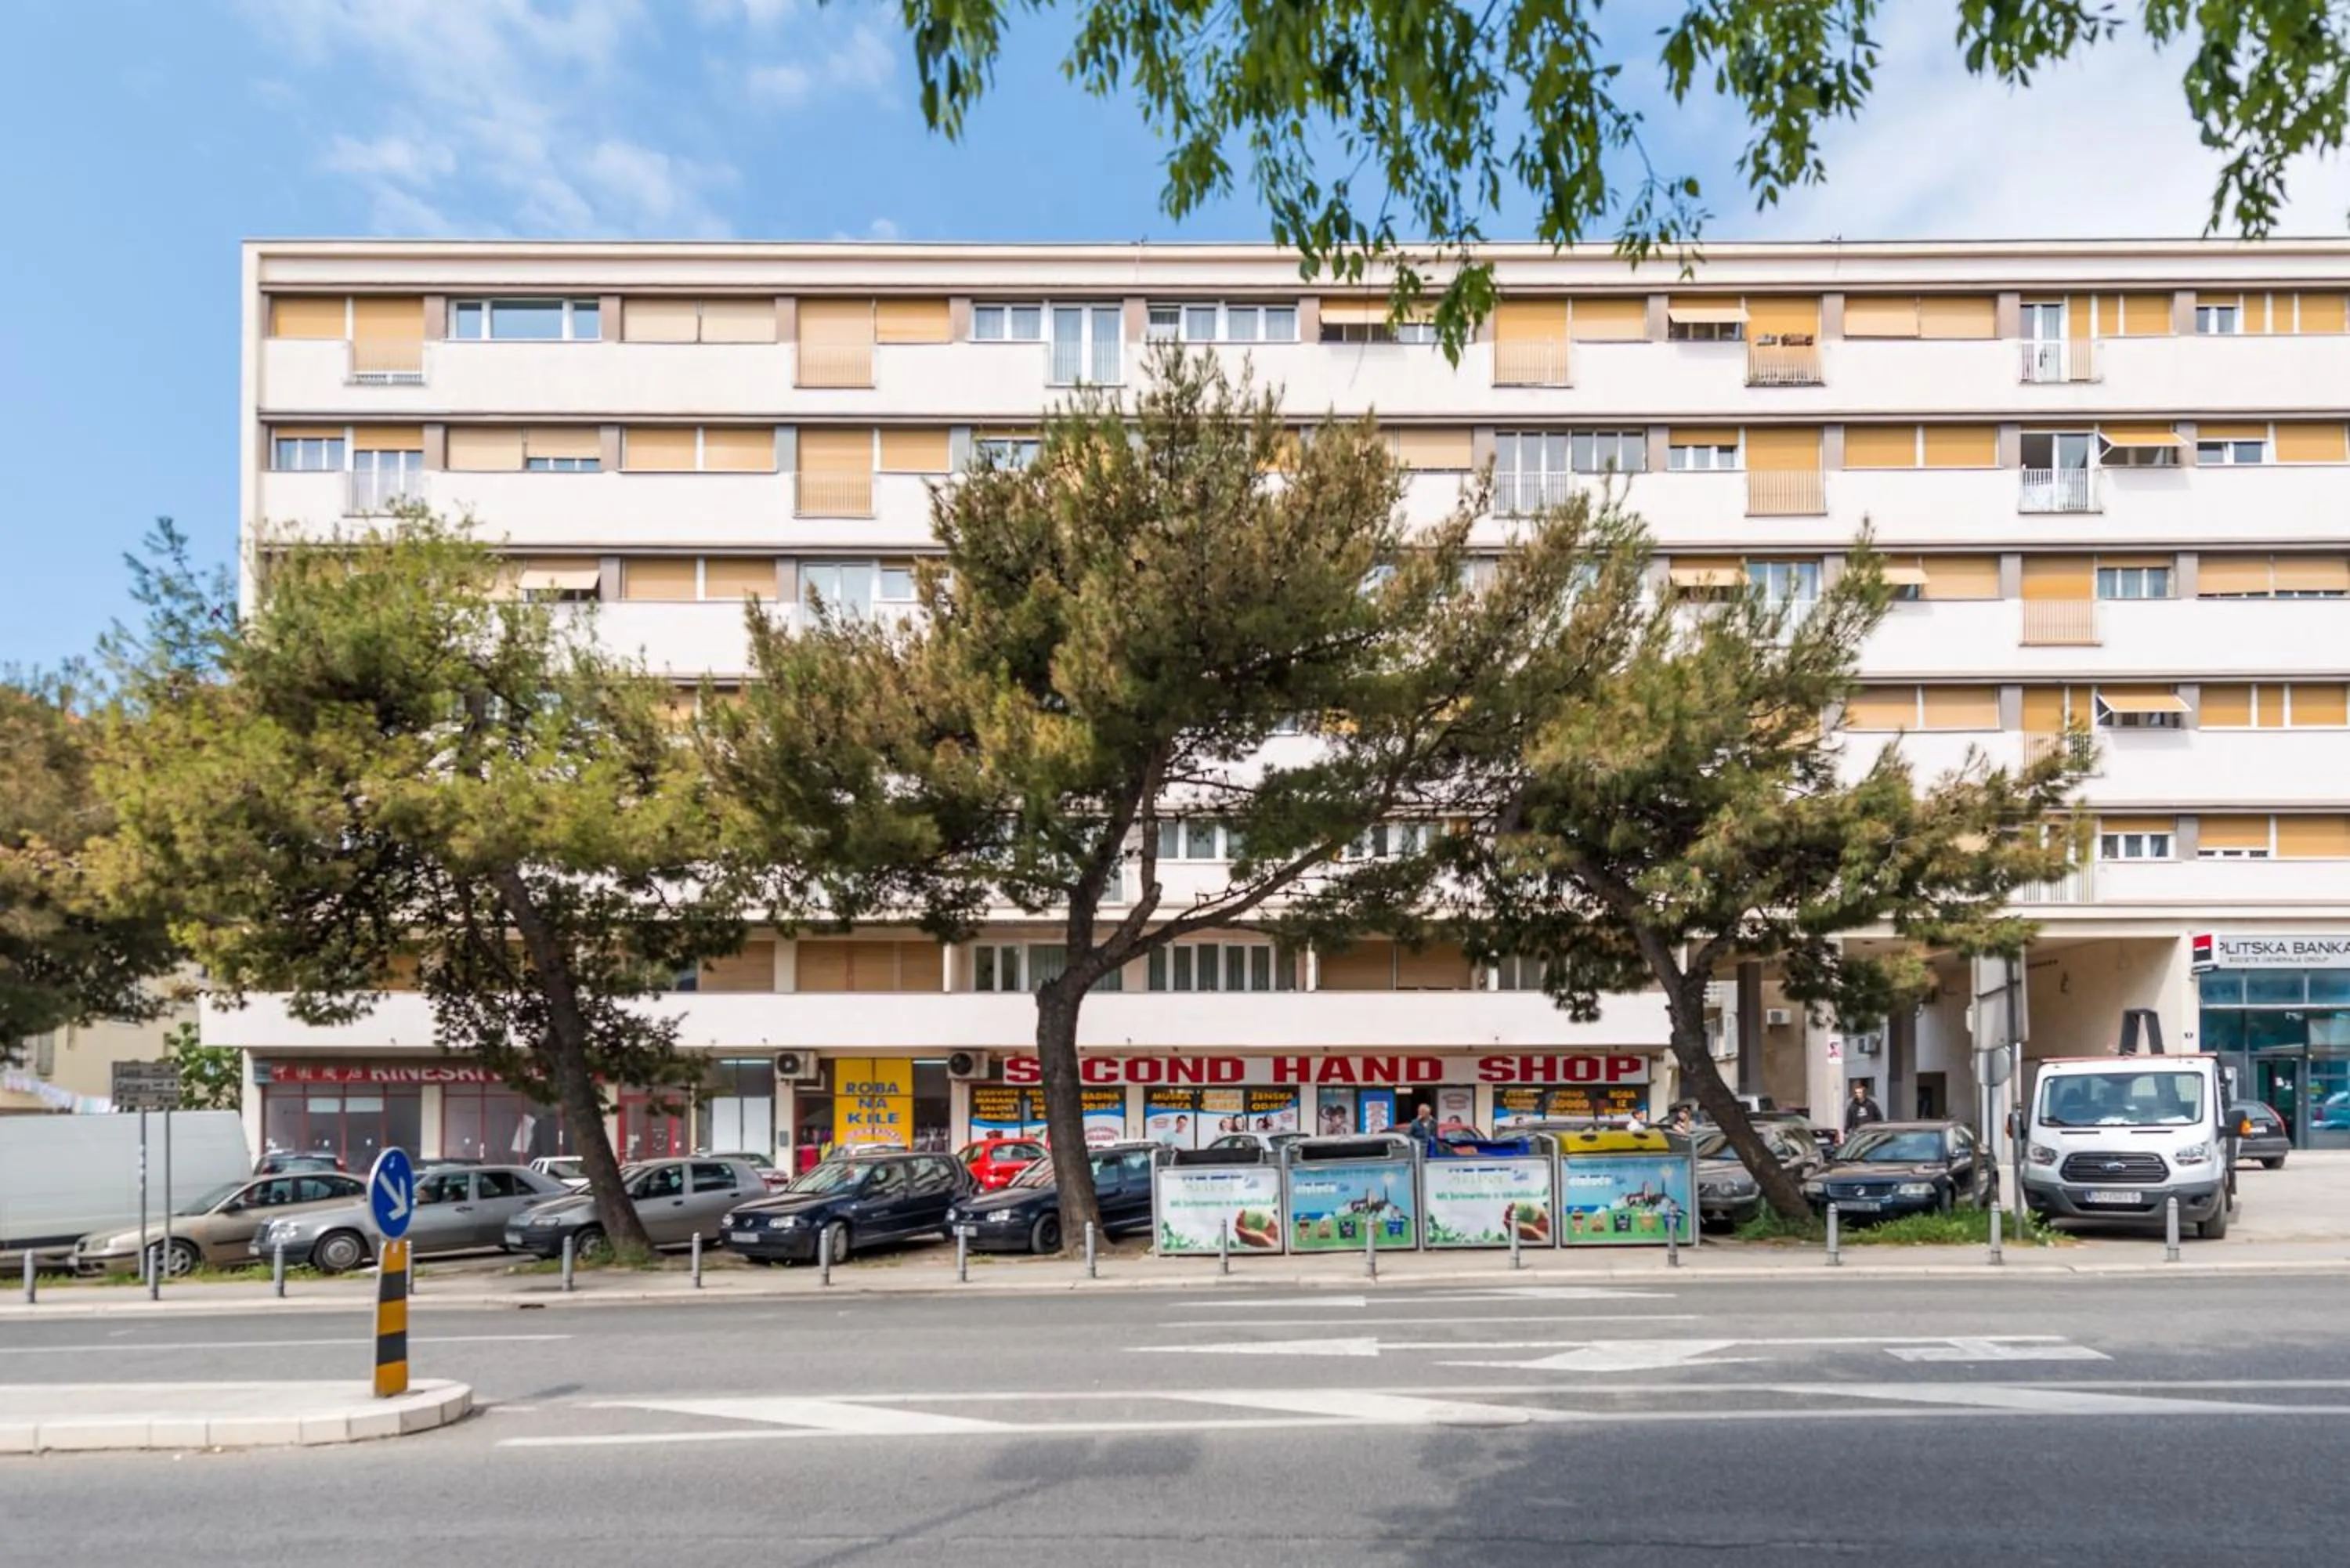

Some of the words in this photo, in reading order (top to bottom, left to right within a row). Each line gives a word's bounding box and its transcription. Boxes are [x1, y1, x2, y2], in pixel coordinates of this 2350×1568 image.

[1007, 1057, 1244, 1082] SCOND
[1273, 1056, 1442, 1082] HAND
[1478, 1056, 1641, 1082] SHOP
[845, 1082, 900, 1094] ROBA
[859, 1097, 888, 1109] NA
[848, 1113, 900, 1124] KILE
